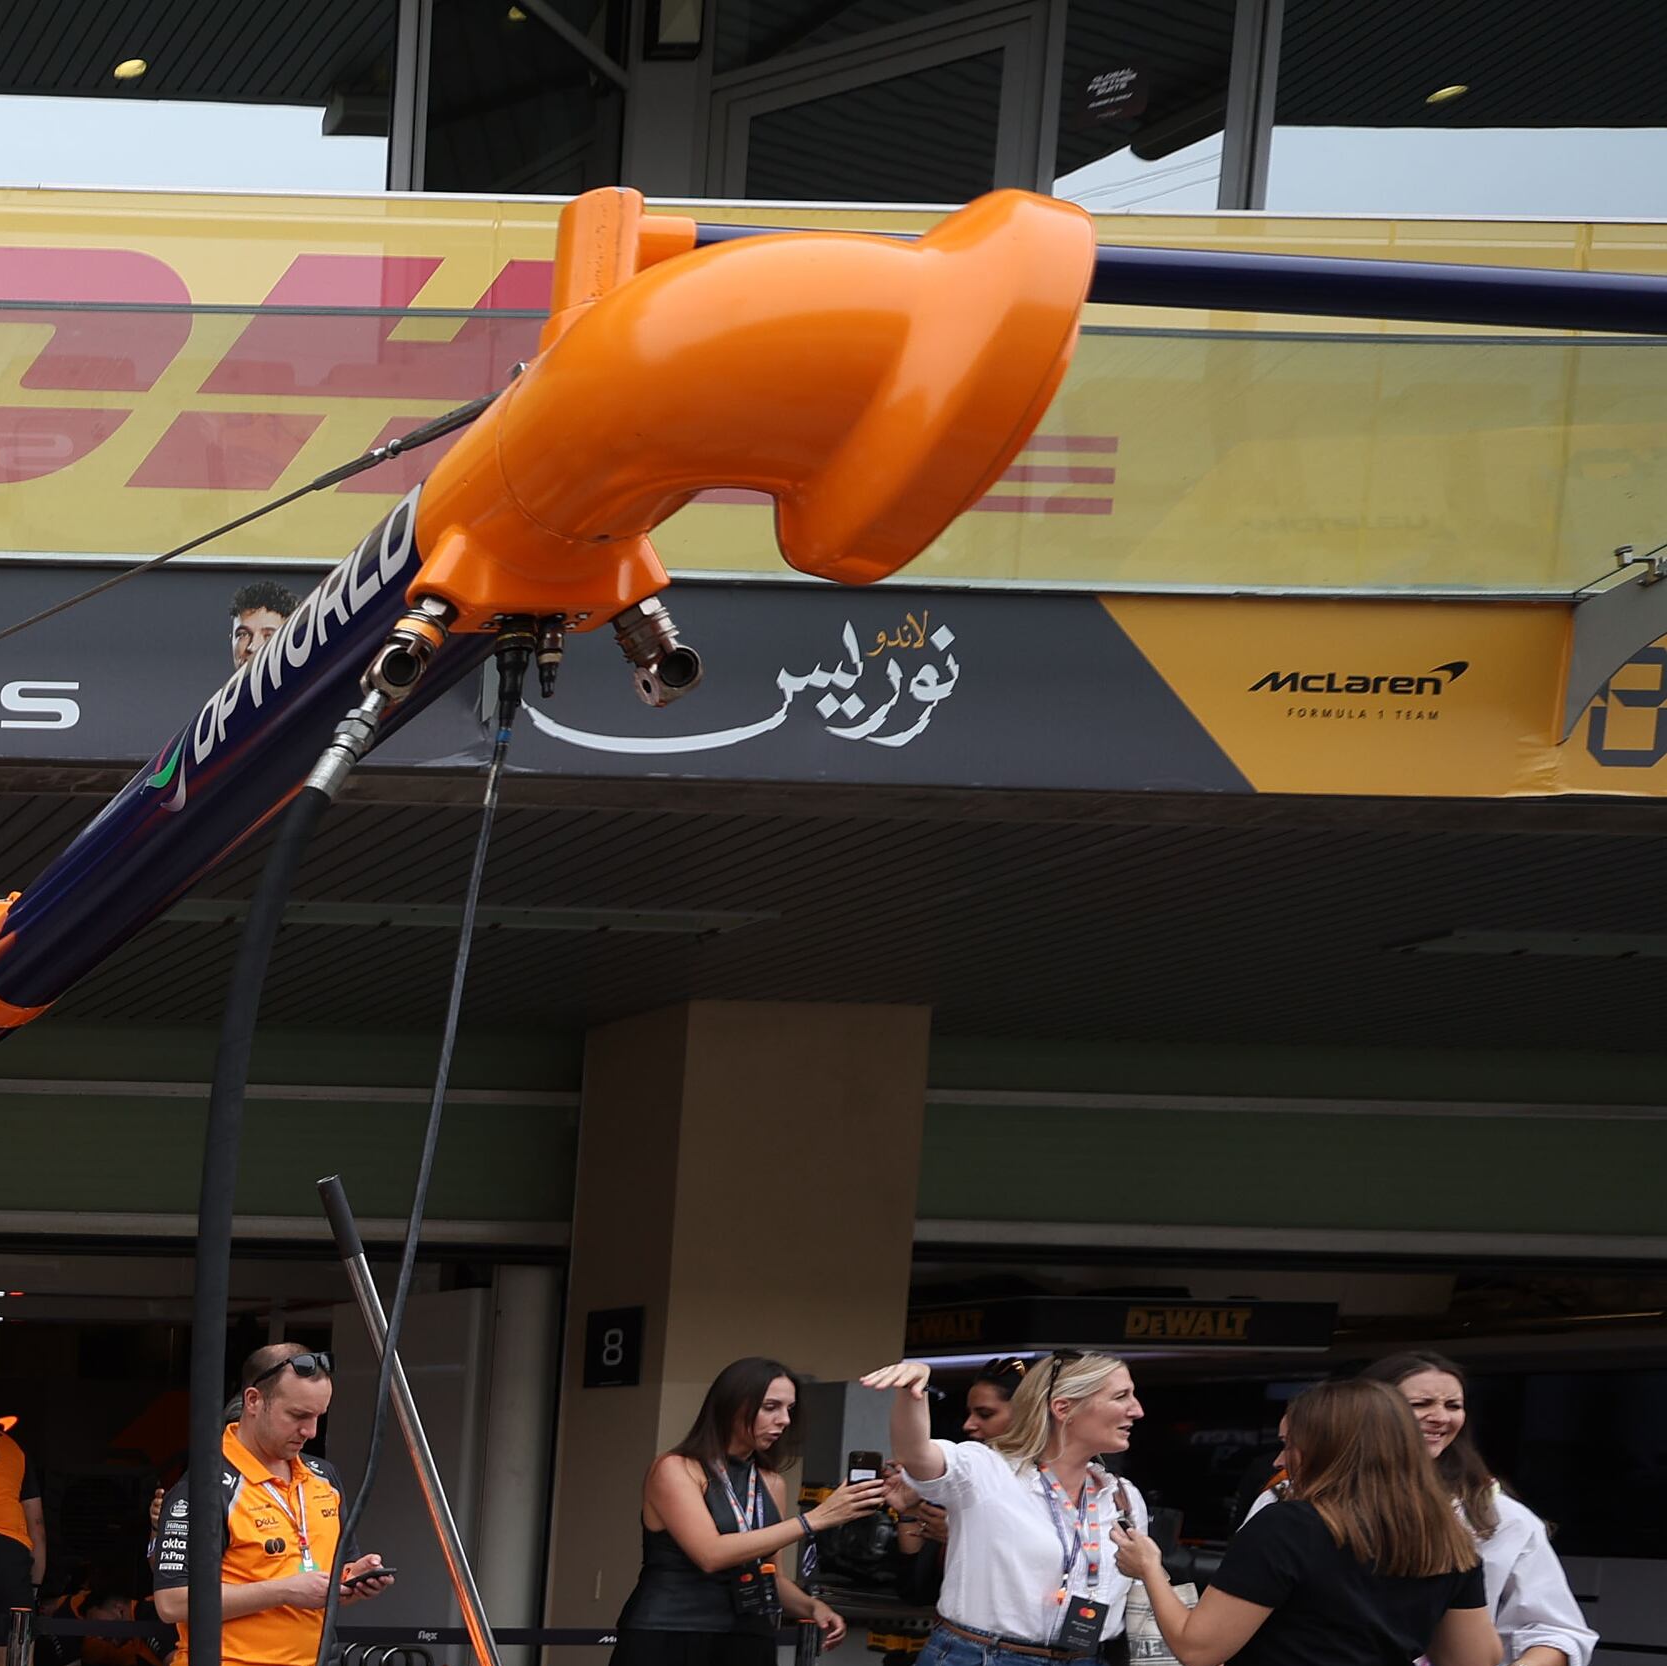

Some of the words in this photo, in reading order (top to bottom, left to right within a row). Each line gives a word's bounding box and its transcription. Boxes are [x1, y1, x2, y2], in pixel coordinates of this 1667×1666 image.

[194, 661, 248, 765] DP
[249, 483, 423, 708] WORLD
[1248, 671, 1442, 695] McLaren
[1287, 707, 1367, 720] FORMULA
[1378, 709, 1385, 720] 1
[1395, 709, 1440, 721] TEAM
[603, 1328, 623, 1366] 8
[167, 1521, 188, 1531] Hilton
[162, 1539, 187, 1549] okta
[160, 1551, 185, 1561] FxPro
